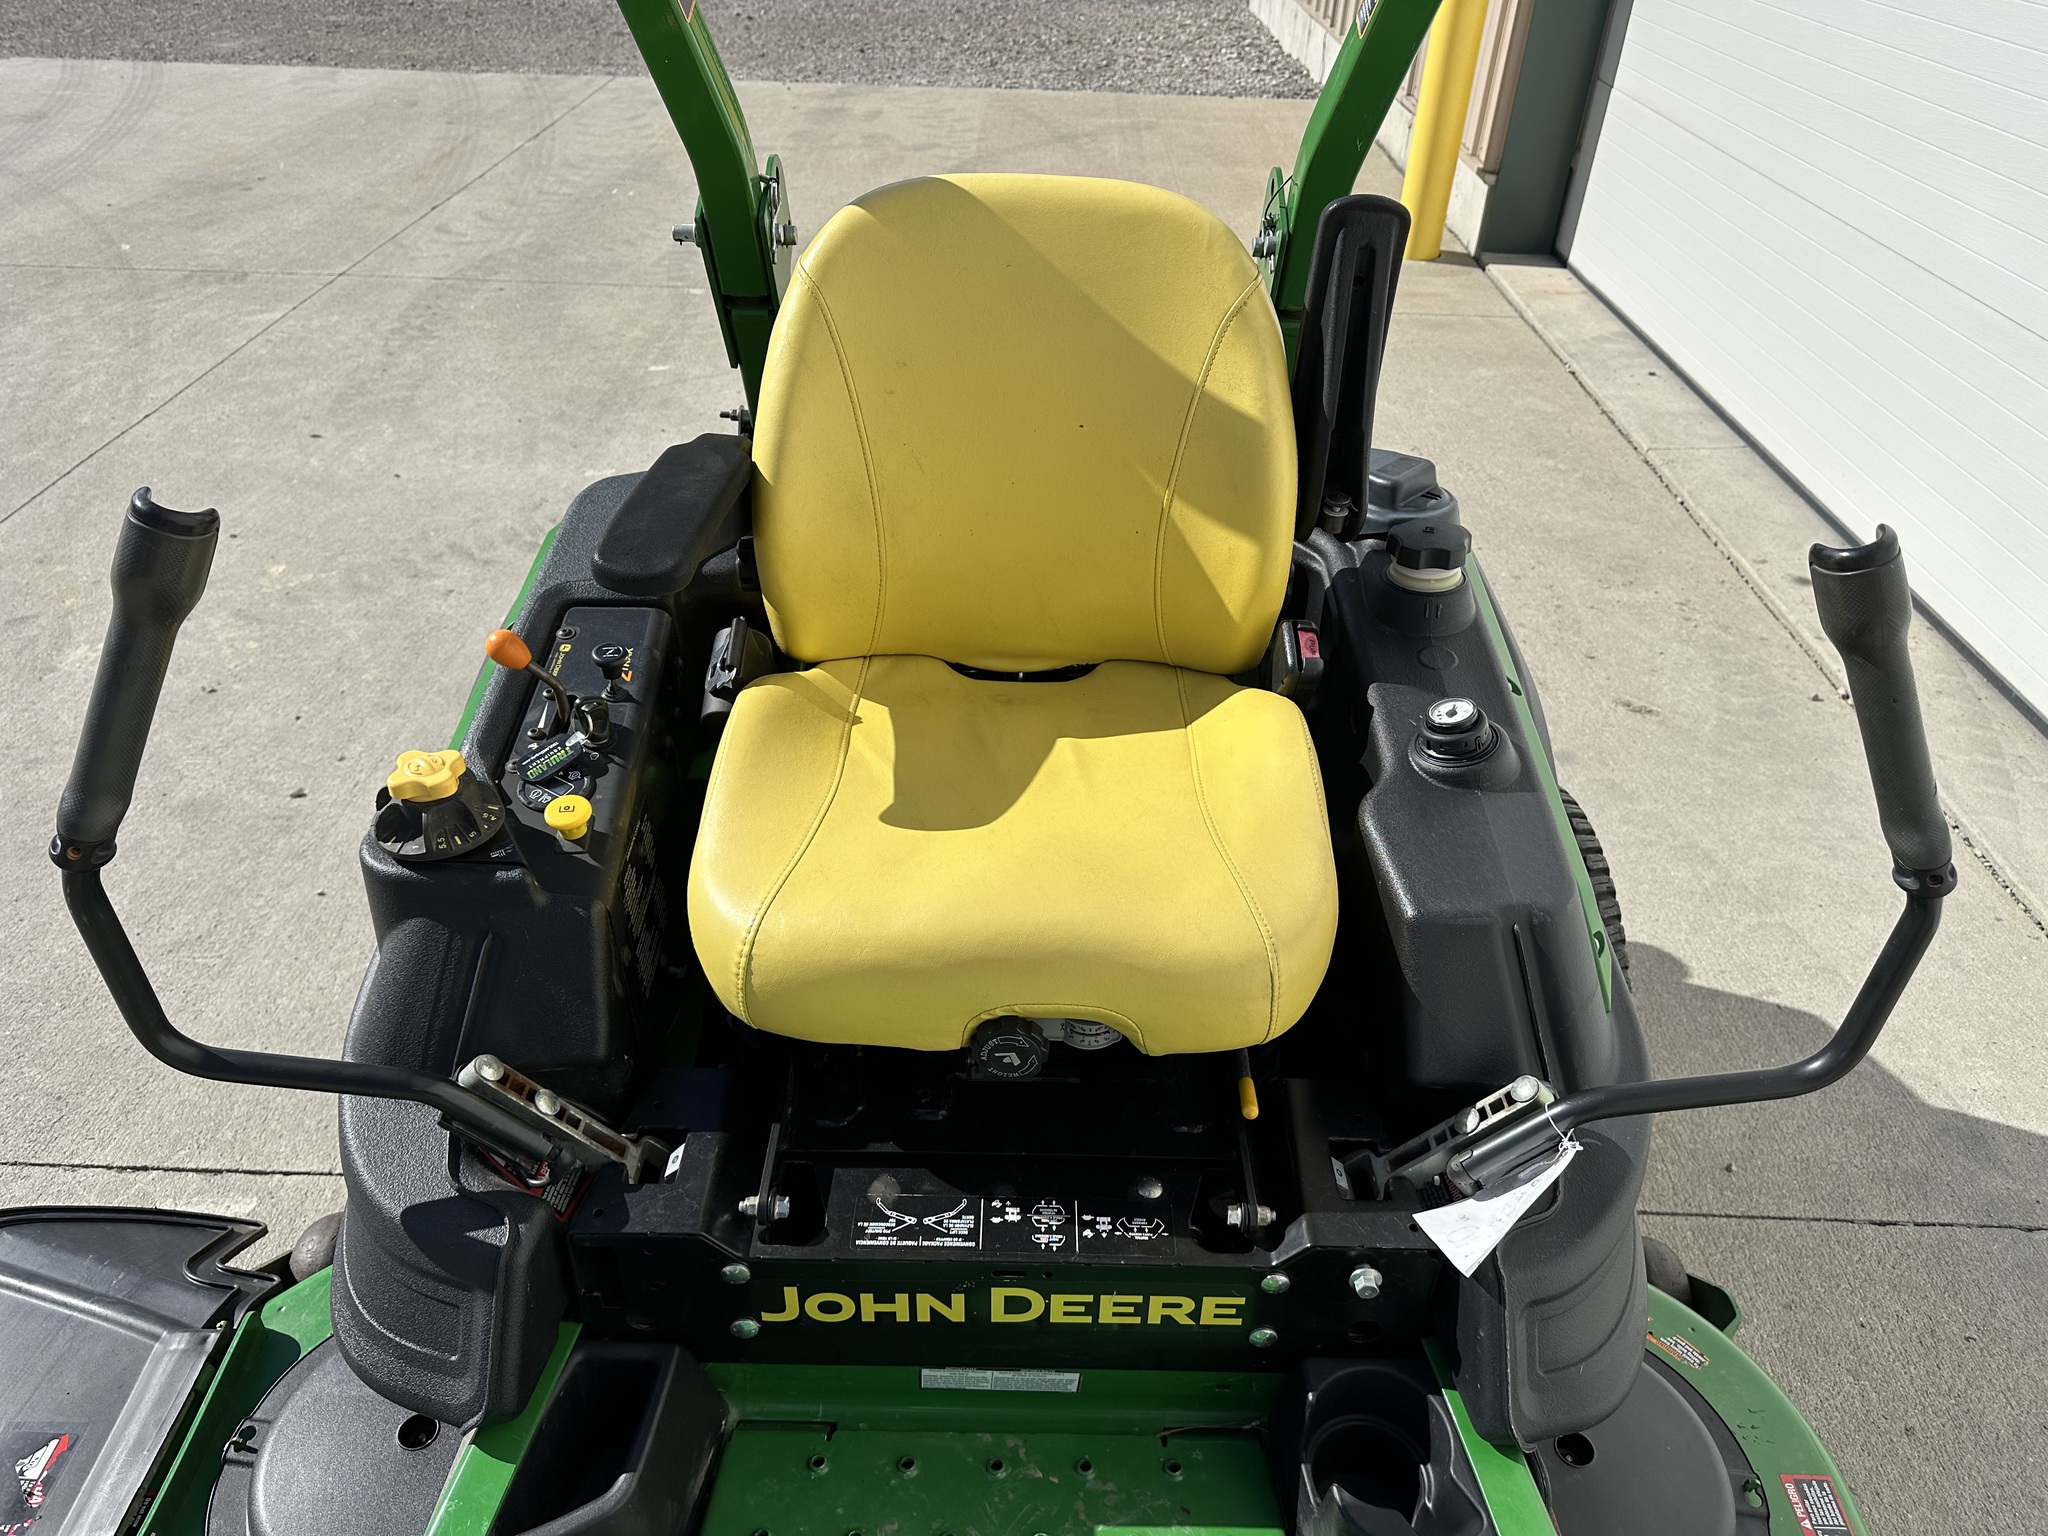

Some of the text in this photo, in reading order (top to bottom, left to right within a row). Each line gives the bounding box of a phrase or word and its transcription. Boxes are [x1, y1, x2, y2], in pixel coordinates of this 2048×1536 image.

[527, 747, 574, 780] TRULAND
[437, 837, 446, 849] 5.5
[980, 1038, 998, 1060] ADJUST
[988, 1067, 1020, 1077] WEIGHT
[761, 1286, 1247, 1326] JOHN DEERE
[1785, 1483, 1806, 1517] PELIGRO
